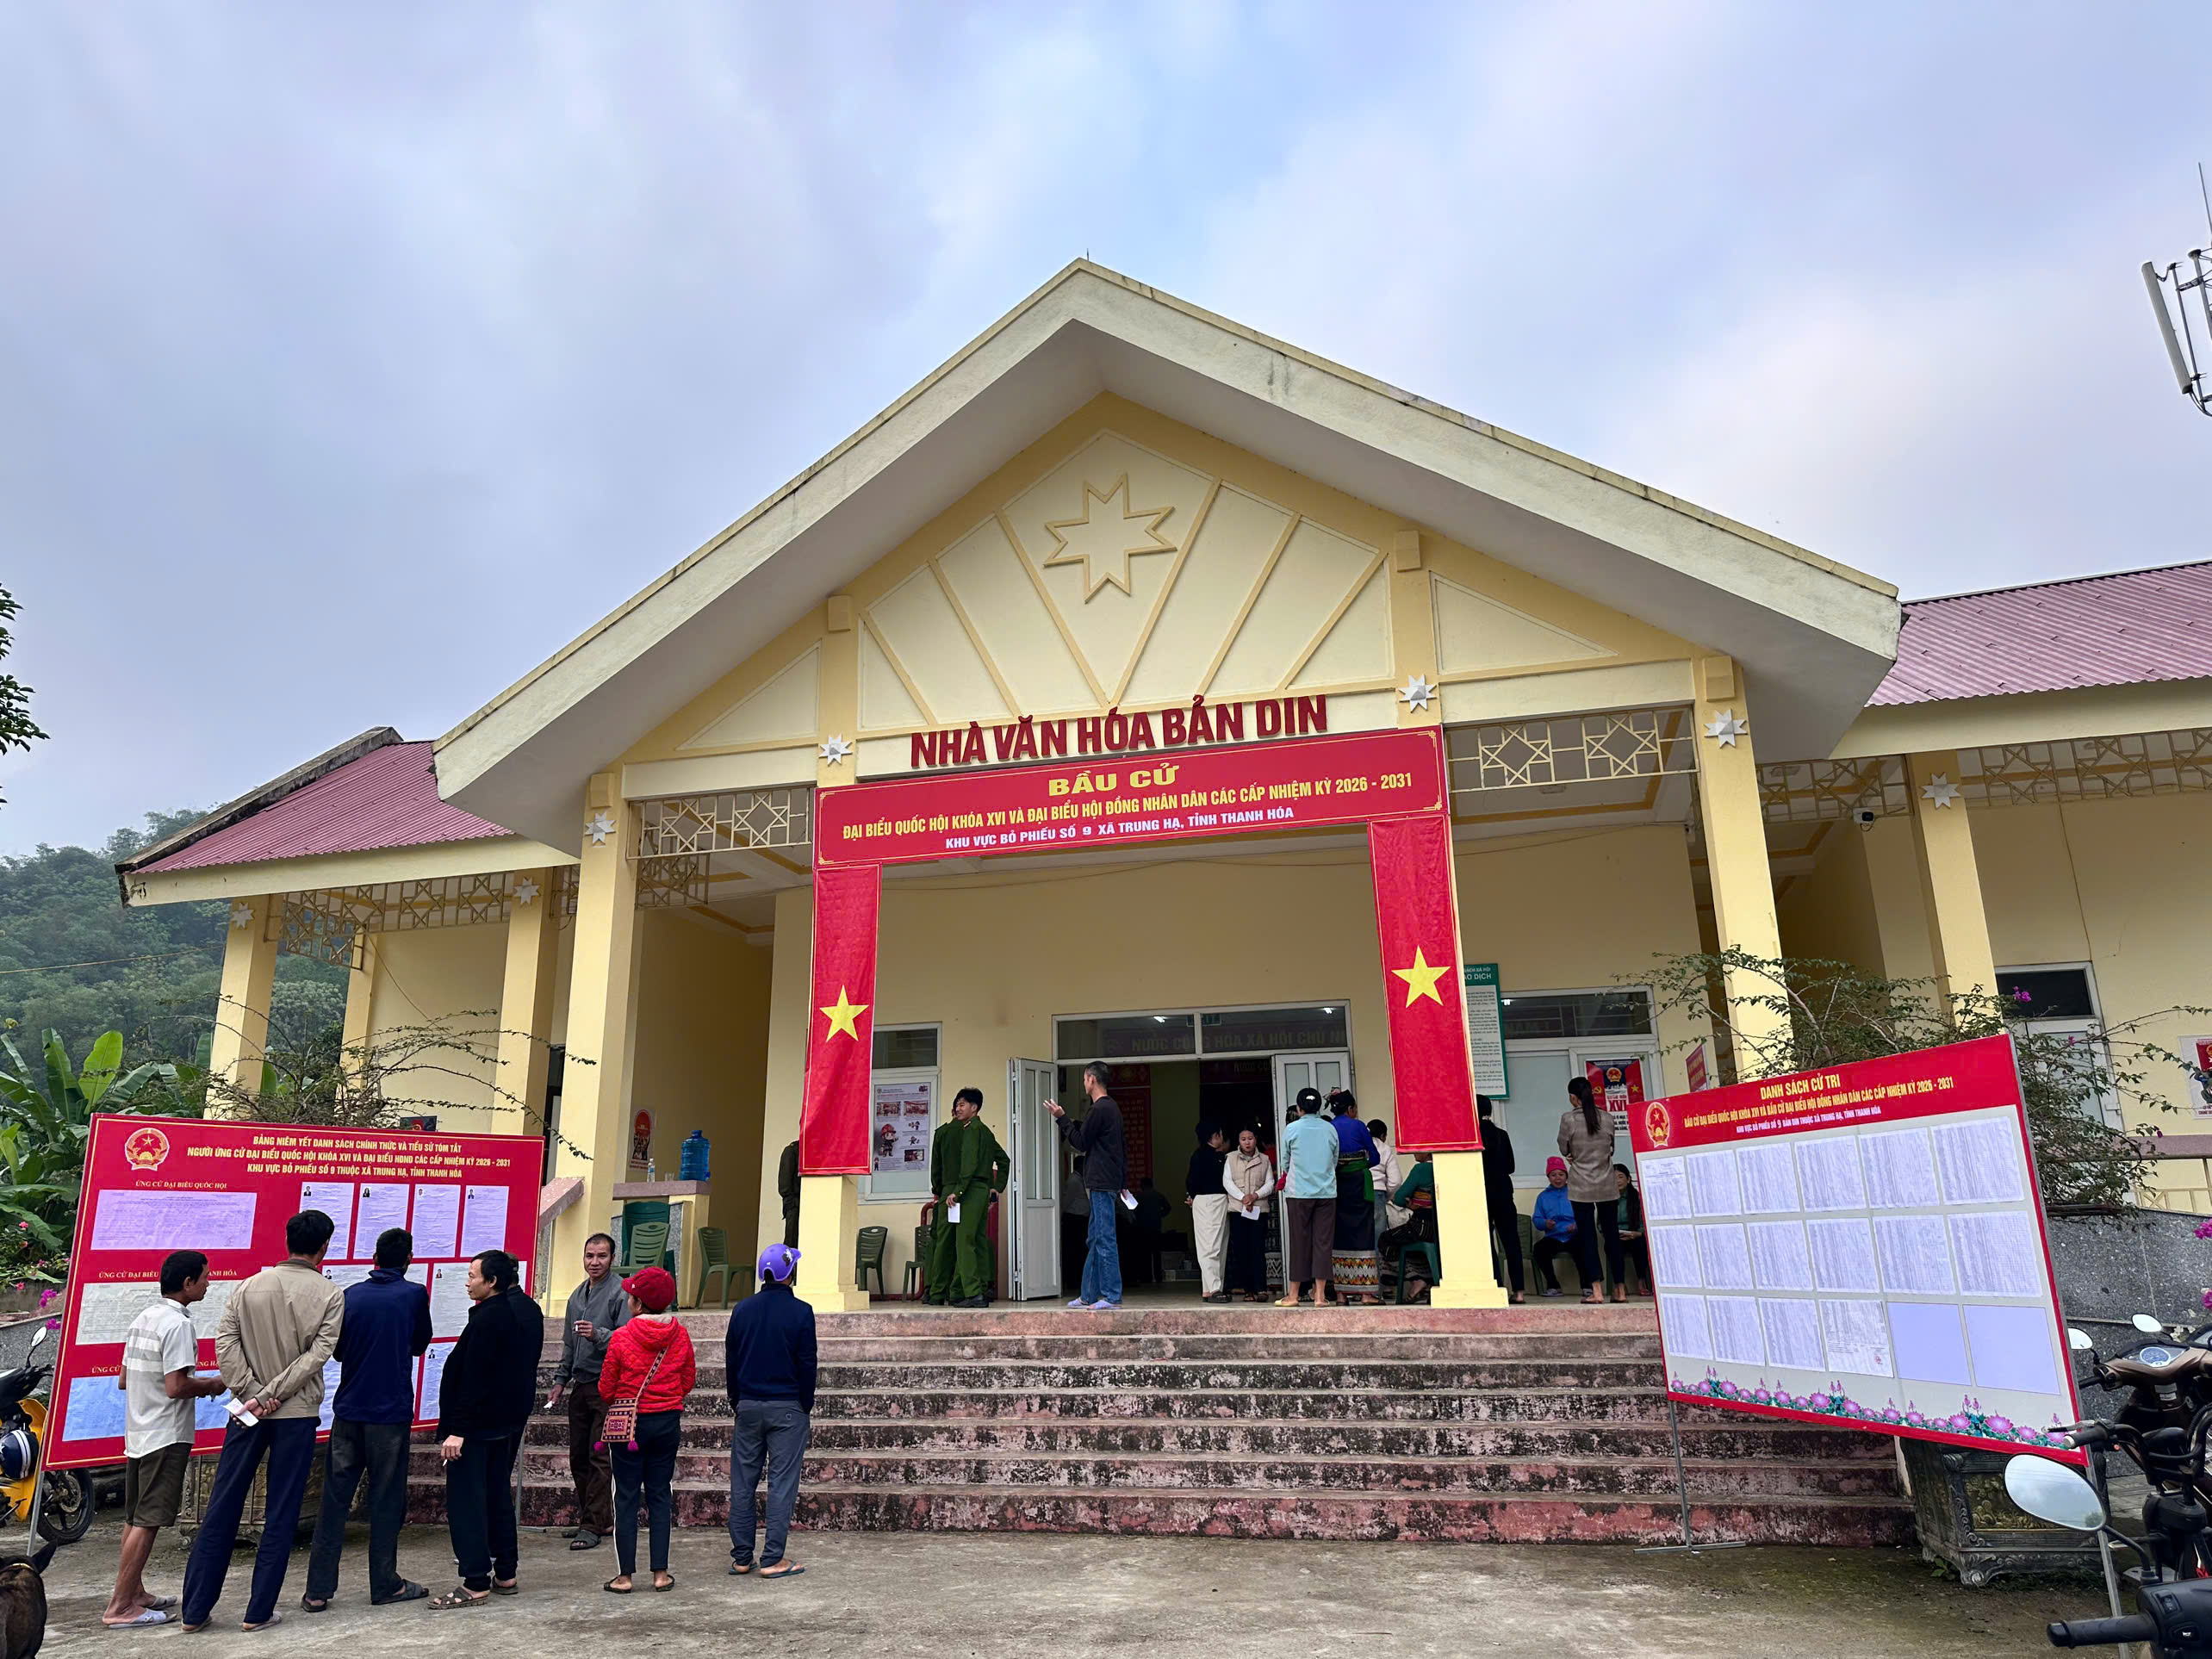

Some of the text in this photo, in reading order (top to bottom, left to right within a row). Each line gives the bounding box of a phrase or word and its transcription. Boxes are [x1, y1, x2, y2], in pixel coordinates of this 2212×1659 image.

[910, 694, 1327, 768] NHÀ VĂN HÓA BẢN DIN
[1048, 762, 1179, 796] BẦU CỬ
[843, 824, 862, 842] ĐẠI
[866, 817, 892, 837] BIỂU
[895, 814, 926, 836] QUỐC
[929, 814, 948, 834] HỘI
[952, 811, 984, 830] KHÓA
[987, 811, 1005, 827] XVI
[1009, 807, 1024, 823] VÀ
[1028, 807, 1048, 824] ĐẠI
[1051, 799, 1078, 820] BIỂU
[1082, 800, 1102, 819] HỘI
[1105, 796, 1140, 815] ĐỒNG
[1143, 792, 1178, 811] NHÂN
[1181, 790, 1207, 807] DÂN
[1210, 786, 1236, 805] CÁC
[1240, 781, 1265, 803] CẤP
[1269, 780, 1311, 800] NHIỆM
[1315, 777, 1332, 795] KỲ
[1335, 777, 1368, 793] 2026
[1381, 773, 1412, 790] 2031
[946, 806, 1294, 848] KHU VỰC BỎ PHIẾU SỐ 9 XÃ TRUNG HẠ, TỈNH THANH HÓA
[1761, 1072, 1841, 1100] DANH SÁCH CỬ TRI
[1861, 1087, 1873, 1101] CÁC
[1873, 1083, 1886, 1099] CẤP
[1886, 1082, 1907, 1098] NHIỆM
[1907, 1080, 1917, 1095] KỲ
[1917, 1080, 1933, 1093] 2026
[1937, 1076, 1954, 1090] 2031
[1777, 1119, 1781, 1128] 9
[187, 1146, 213, 1157] NGƯỜI
[214, 1146, 232, 1158] ỨNG
[233, 1146, 246, 1159] CỬ
[246, 1150, 259, 1160] ĐẠI
[261, 1147, 279, 1159] BIỂU
[281, 1148, 301, 1160] QUỐC
[303, 1150, 316, 1161] HỘI
[318, 1151, 337, 1161] KHÓA
[339, 1153, 351, 1162] XVI
[352, 1153, 362, 1162] VÀ
[363, 1153, 376, 1164] ĐẠI
[377, 1152, 393, 1163] BIỂU
[414, 1154, 428, 1165] CÁC
[429, 1154, 443, 1165] CẤP
[444, 1156, 464, 1166] NHIỆM
[466, 1157, 475, 1165] KỲ
[253, 1134, 275, 1145] BẢNG
[276, 1135, 296, 1146] NIÊM
[299, 1135, 312, 1146] YẾT
[313, 1138, 333, 1147] DANH
[335, 1138, 354, 1149] SÁCH
[356, 1140, 377, 1150] CHÍNH
[379, 1140, 396, 1151] THỨC
[398, 1141, 407, 1151] VÀ
[408, 1140, 423, 1151] TIỂU
[424, 1141, 434, 1152] SỬ
[435, 1143, 449, 1153] TÓM
[247, 1164, 263, 1172] KHU
[265, 1164, 280, 1174] VỰC
[283, 1162, 293, 1173] BỎ
[295, 1163, 317, 1173] PHIẾU
[319, 1163, 329, 1174] SỐ
[330, 1165, 334, 1174] 9
[337, 1165, 359, 1176] THUỘC
[362, 1165, 370, 1175] XÃ
[373, 1167, 395, 1176] TRUNG
[397, 1168, 408, 1177] HẠ,
[410, 1166, 426, 1177] TỈNH
[449, 1168, 462, 1177] HÓA
[98, 1270, 115, 1278] ỨNG
[128, 1271, 141, 1279] ĐẠI
